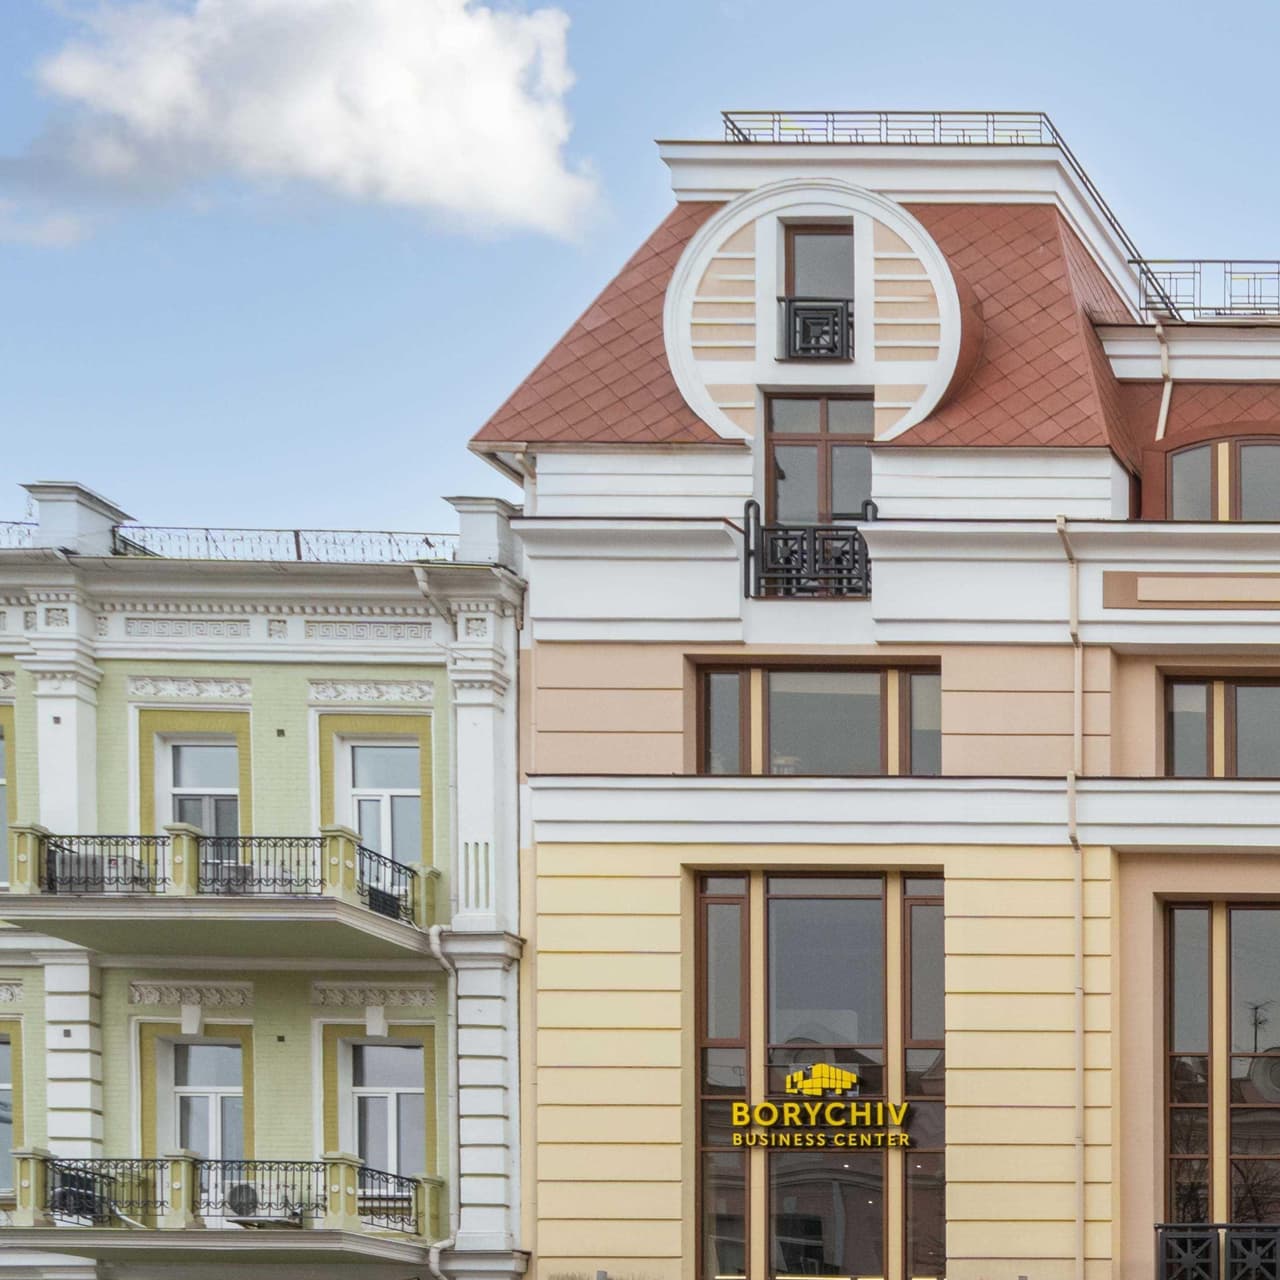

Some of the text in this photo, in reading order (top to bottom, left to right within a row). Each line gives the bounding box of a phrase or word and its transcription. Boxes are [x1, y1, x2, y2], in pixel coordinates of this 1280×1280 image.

[732, 1101, 908, 1127] BORYCHIV
[732, 1132, 910, 1147] BUSINESS CENTER
